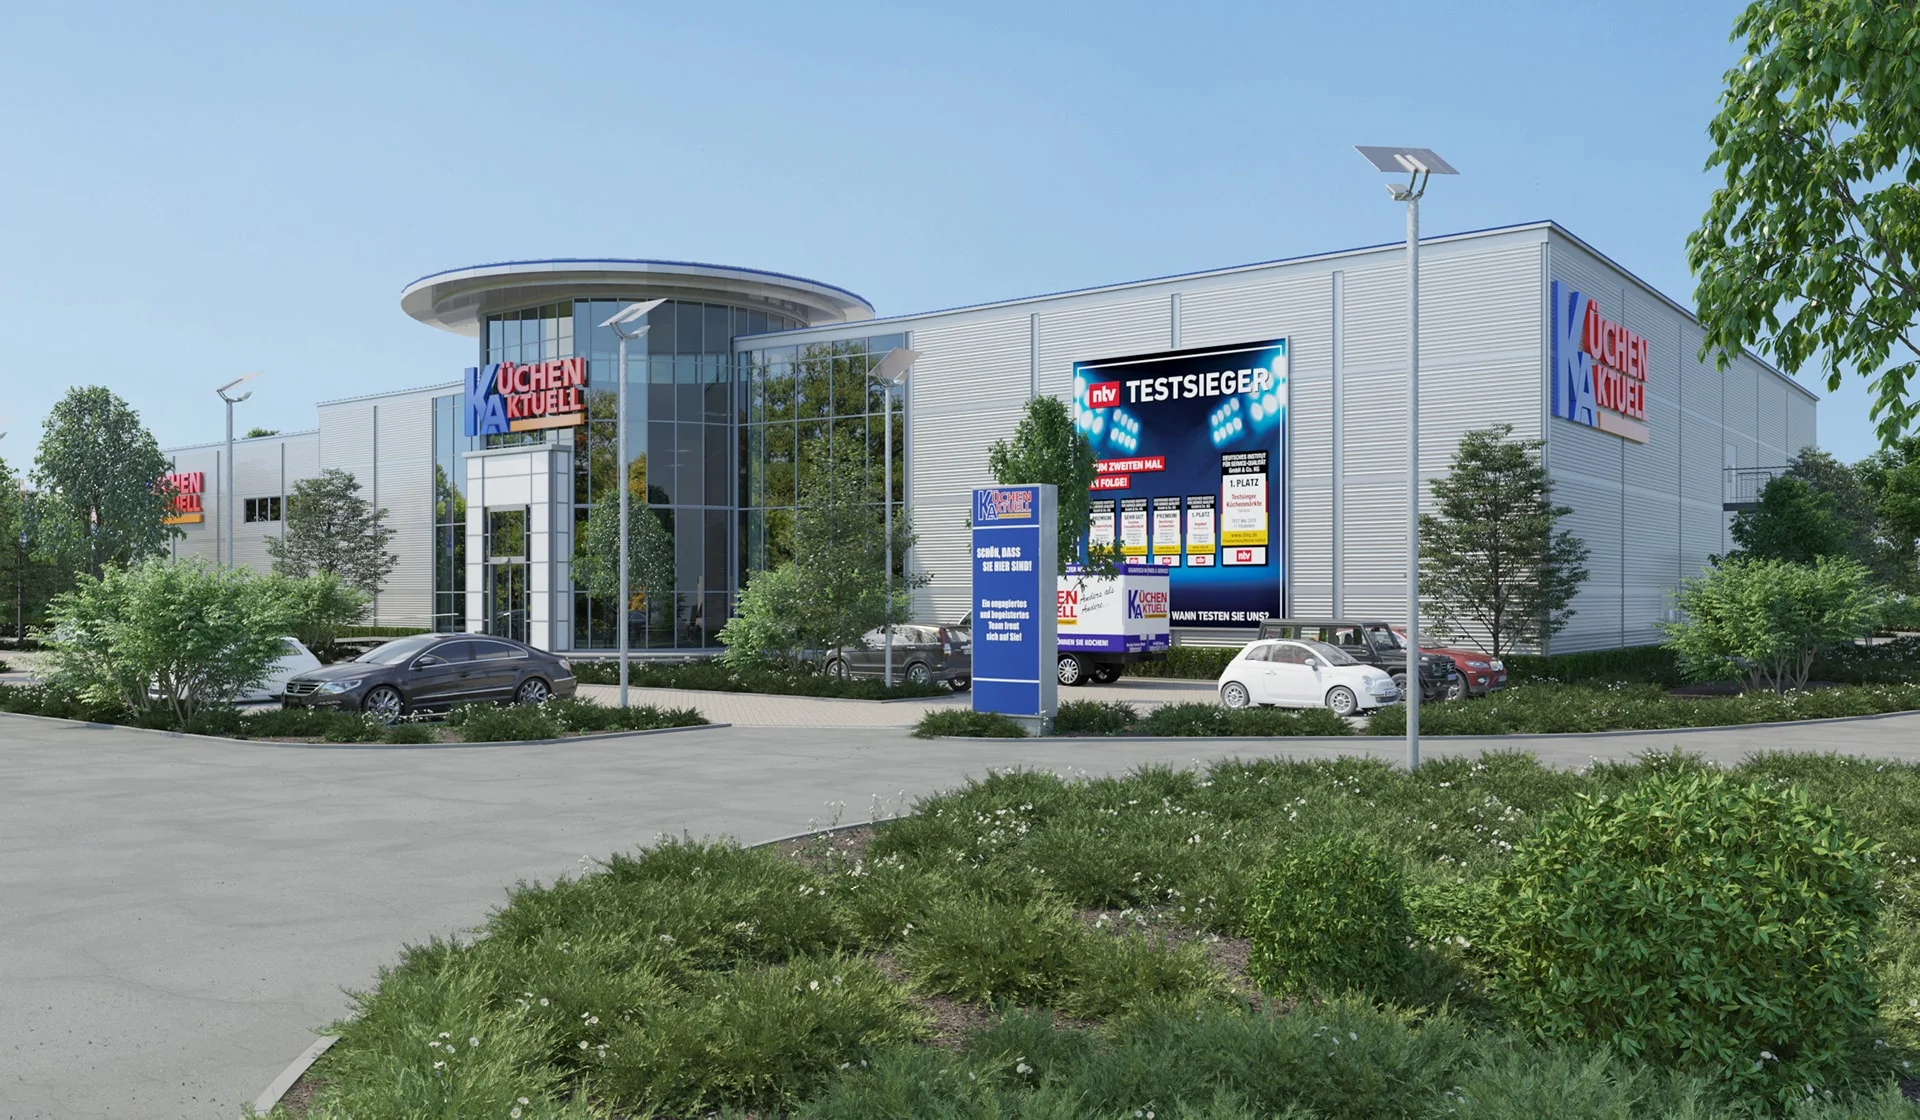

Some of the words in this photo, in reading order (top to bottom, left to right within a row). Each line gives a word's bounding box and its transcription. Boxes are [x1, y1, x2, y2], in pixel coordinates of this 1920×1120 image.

[1126, 367, 1270, 404] TESTSIEGER
[1092, 384, 1117, 404] ntv
[480, 386, 585, 435] AKTUELL
[1109, 460, 1143, 471] ZWEITEN
[1145, 459, 1163, 469] MAL
[1101, 477, 1127, 488] FOLGE!
[1236, 478, 1259, 487] PLATZ
[976, 546, 1000, 559] SCHÖN,
[1001, 546, 1021, 558] DASS
[982, 561, 993, 572] SIE
[994, 561, 1010, 572] HIER
[1011, 560, 1032, 571] SIND!
[982, 599, 990, 608] Ein
[991, 599, 1027, 609] engagiertes
[980, 610, 991, 619] und
[991, 610, 1030, 620] begeistertes
[1134, 604, 1167, 619] AKTUELL
[1171, 611, 1196, 620] WANN
[1198, 611, 1228, 621] TESTEN
[1231, 612, 1245, 621] SIE
[1246, 612, 1269, 622] UNS?
[988, 621, 1004, 630] Team
[1004, 621, 1019, 630] freut
[986, 632, 998, 641] sich
[999, 632, 1009, 641] auf
[1010, 632, 1022, 641] Sie!
[1085, 639, 1109, 647] KOCHEN!
